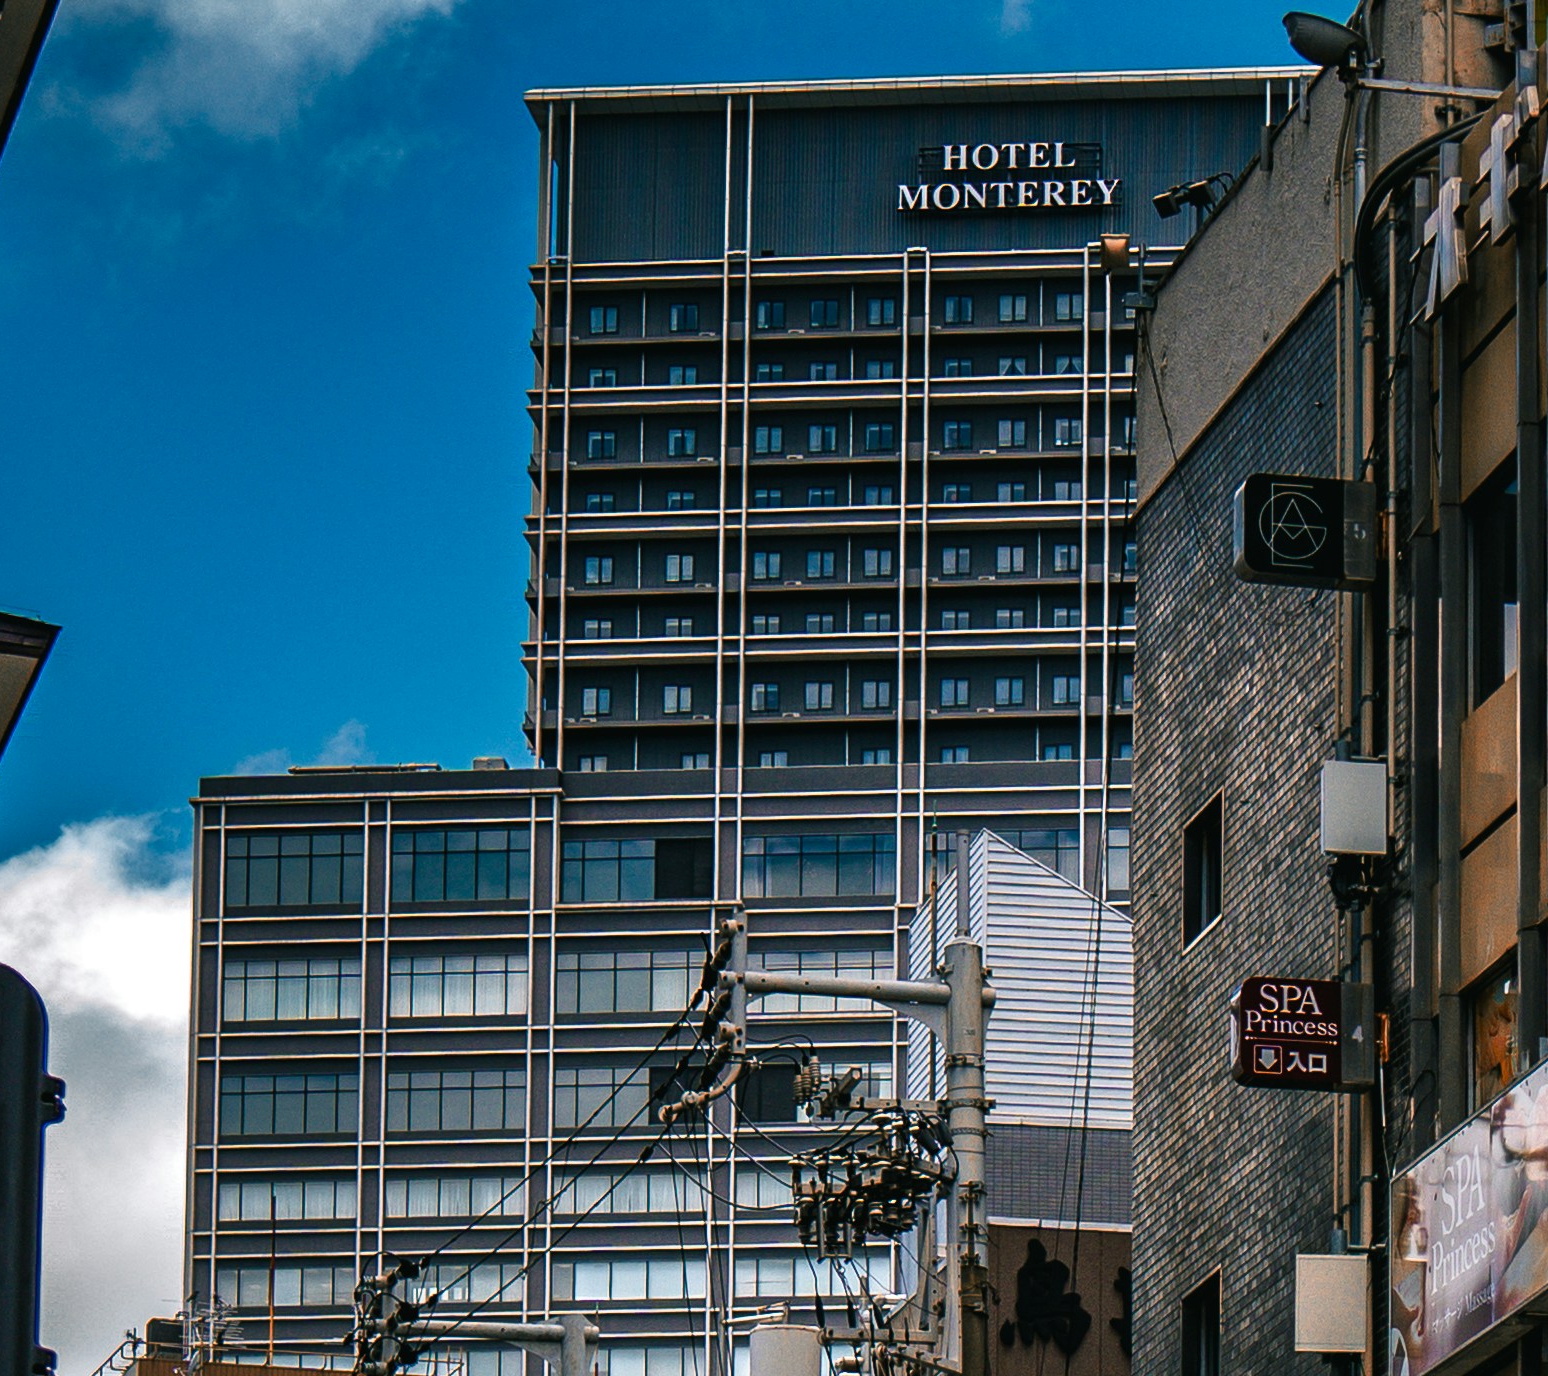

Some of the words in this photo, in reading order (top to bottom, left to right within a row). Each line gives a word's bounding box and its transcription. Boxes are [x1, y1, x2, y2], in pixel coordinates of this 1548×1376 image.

[942, 142, 1076, 171] HOTEL
[897, 178, 1122, 212] MONTEREY
[1258, 982, 1322, 1015] SPA
[1243, 1010, 1340, 1041] Princess
[1286, 1050, 1328, 1076] 入口
[1442, 1144, 1485, 1236] SPA
[1430, 1220, 1496, 1296] Princess
